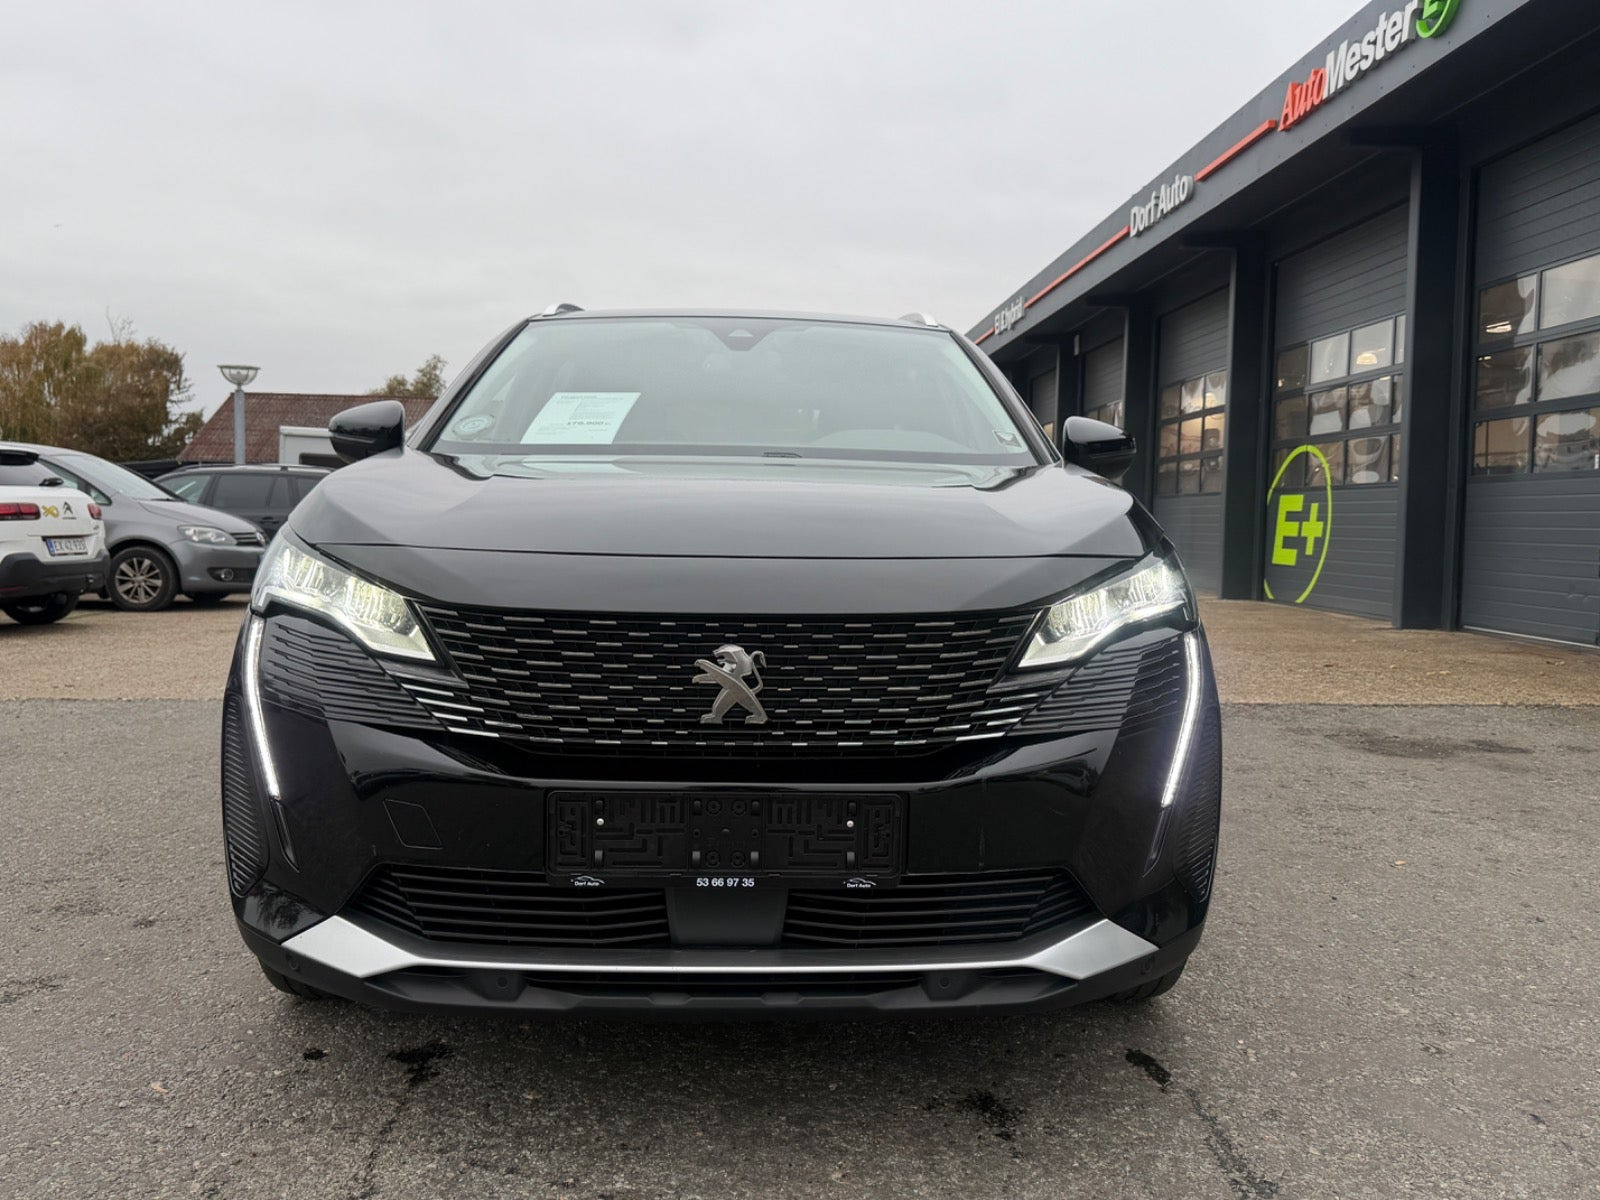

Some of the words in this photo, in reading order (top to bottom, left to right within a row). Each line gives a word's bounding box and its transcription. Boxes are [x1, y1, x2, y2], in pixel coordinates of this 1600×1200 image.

[1278, 0, 1417, 132] AutoMester
[1129, 190, 1157, 237] Dorf
[1157, 174, 1192, 219] Auto
[1272, 494, 1324, 566] E+
[696, 877, 709, 887] 53
[711, 877, 724, 887] 66
[727, 877, 739, 887] 97
[742, 877, 755, 887] 35
